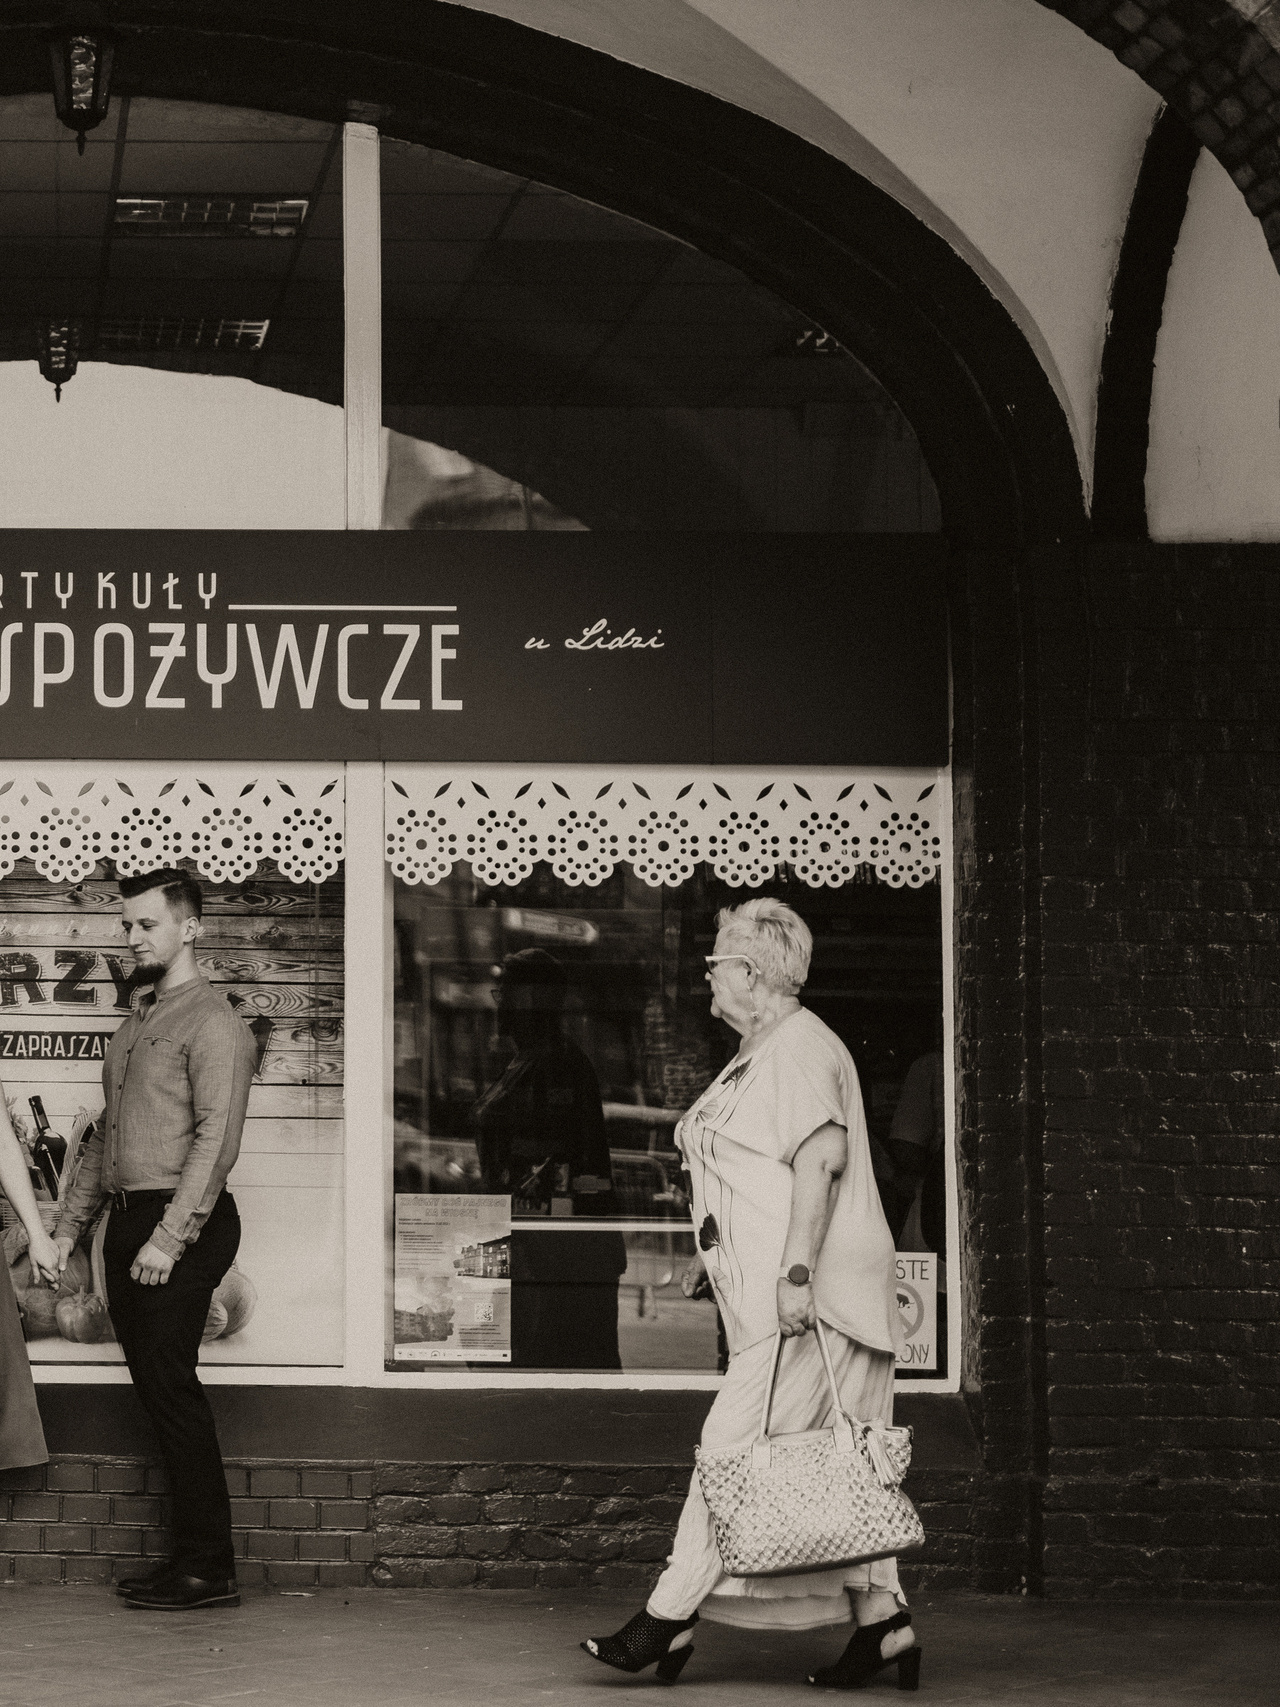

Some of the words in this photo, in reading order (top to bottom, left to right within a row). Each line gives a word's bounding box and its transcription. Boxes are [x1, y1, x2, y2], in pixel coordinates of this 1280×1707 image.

[524, 637, 551, 650] u
[564, 618, 665, 651] Lidzi
[895, 1259, 930, 1280] STE
[895, 1343, 930, 1364] ONY
